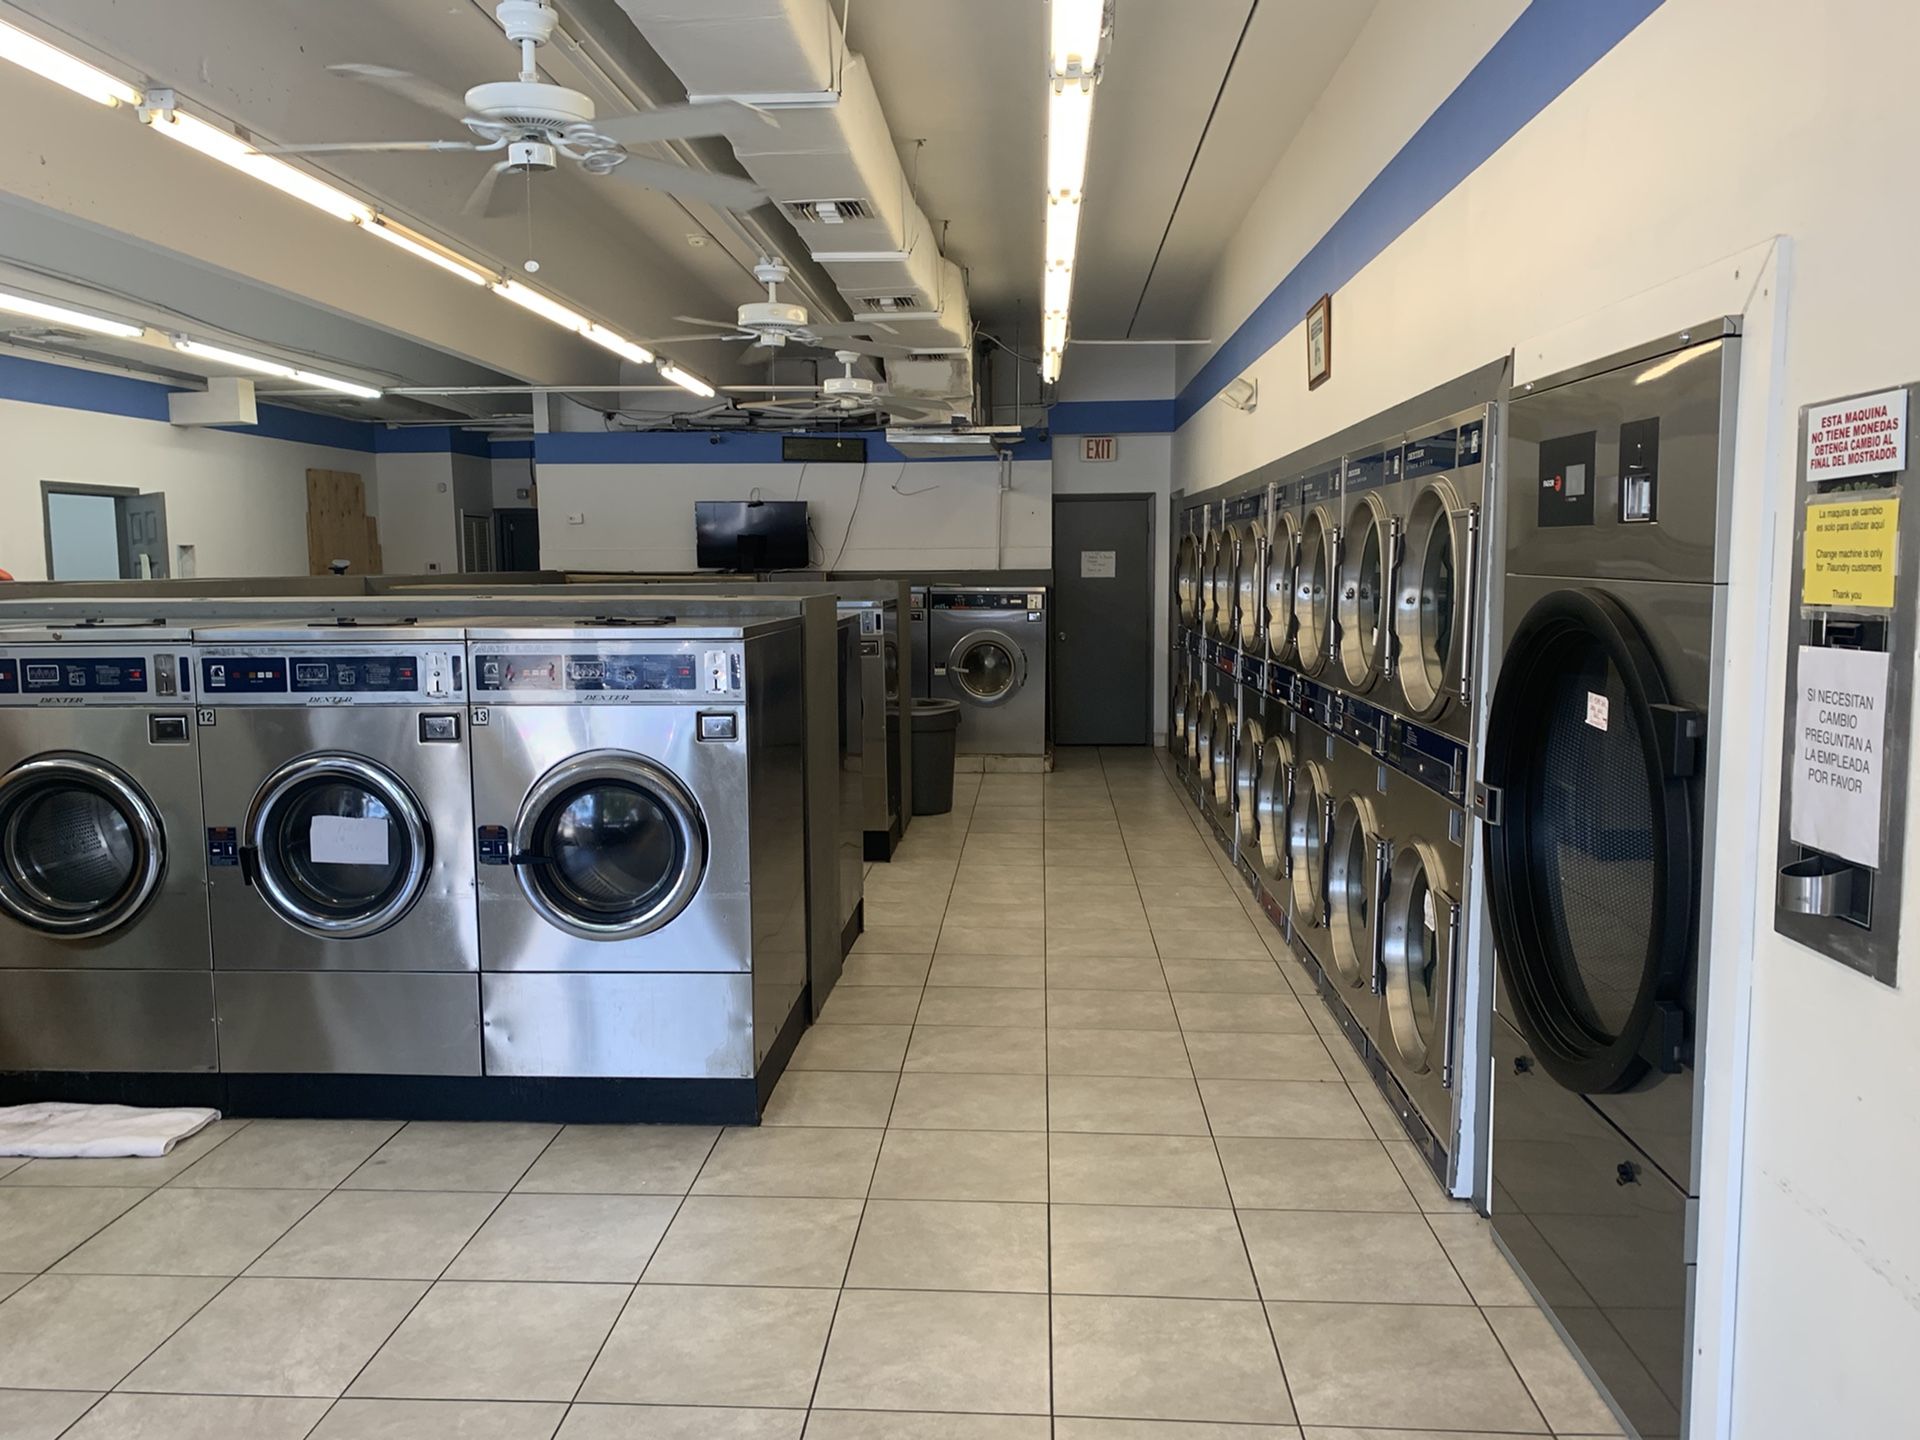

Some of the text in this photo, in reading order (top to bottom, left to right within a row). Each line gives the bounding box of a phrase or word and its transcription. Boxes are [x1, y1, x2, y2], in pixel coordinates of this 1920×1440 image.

[1822, 405, 1887, 428] ESTA MAQUINA
[1812, 418, 1899, 444] NO TIENE MONEDAS
[1086, 439, 1112, 459] EXIT
[1815, 434, 1893, 456] OBTENGA CAMBIO AL
[1810, 447, 1897, 469] FINAL DEL MOSTRADOR
[1827, 509, 1850, 519] maquina
[1852, 508, 1859, 516] de
[1860, 506, 1884, 516] cambio
[1816, 524, 1823, 532] es
[1824, 523, 1835, 531] solo
[1836, 523, 1849, 533] para
[1850, 521, 1869, 530] utilizar
[1816, 548, 1883, 560] Change machine is only
[1816, 563, 1824, 572] for
[1851, 564, 1882, 572] customers
[1832, 589, 1862, 601] Thank you
[1807, 688, 1874, 710] SI NECESITAN
[200, 711, 213, 722] 12
[473, 711, 487, 722] 13
[1819, 710, 1857, 729] CAMBIO
[1805, 727, 1872, 753] PREGUNTAN A
[1805, 747, 1870, 774] LA EMPLEADA
[1808, 768, 1862, 794] POR FAVOR
